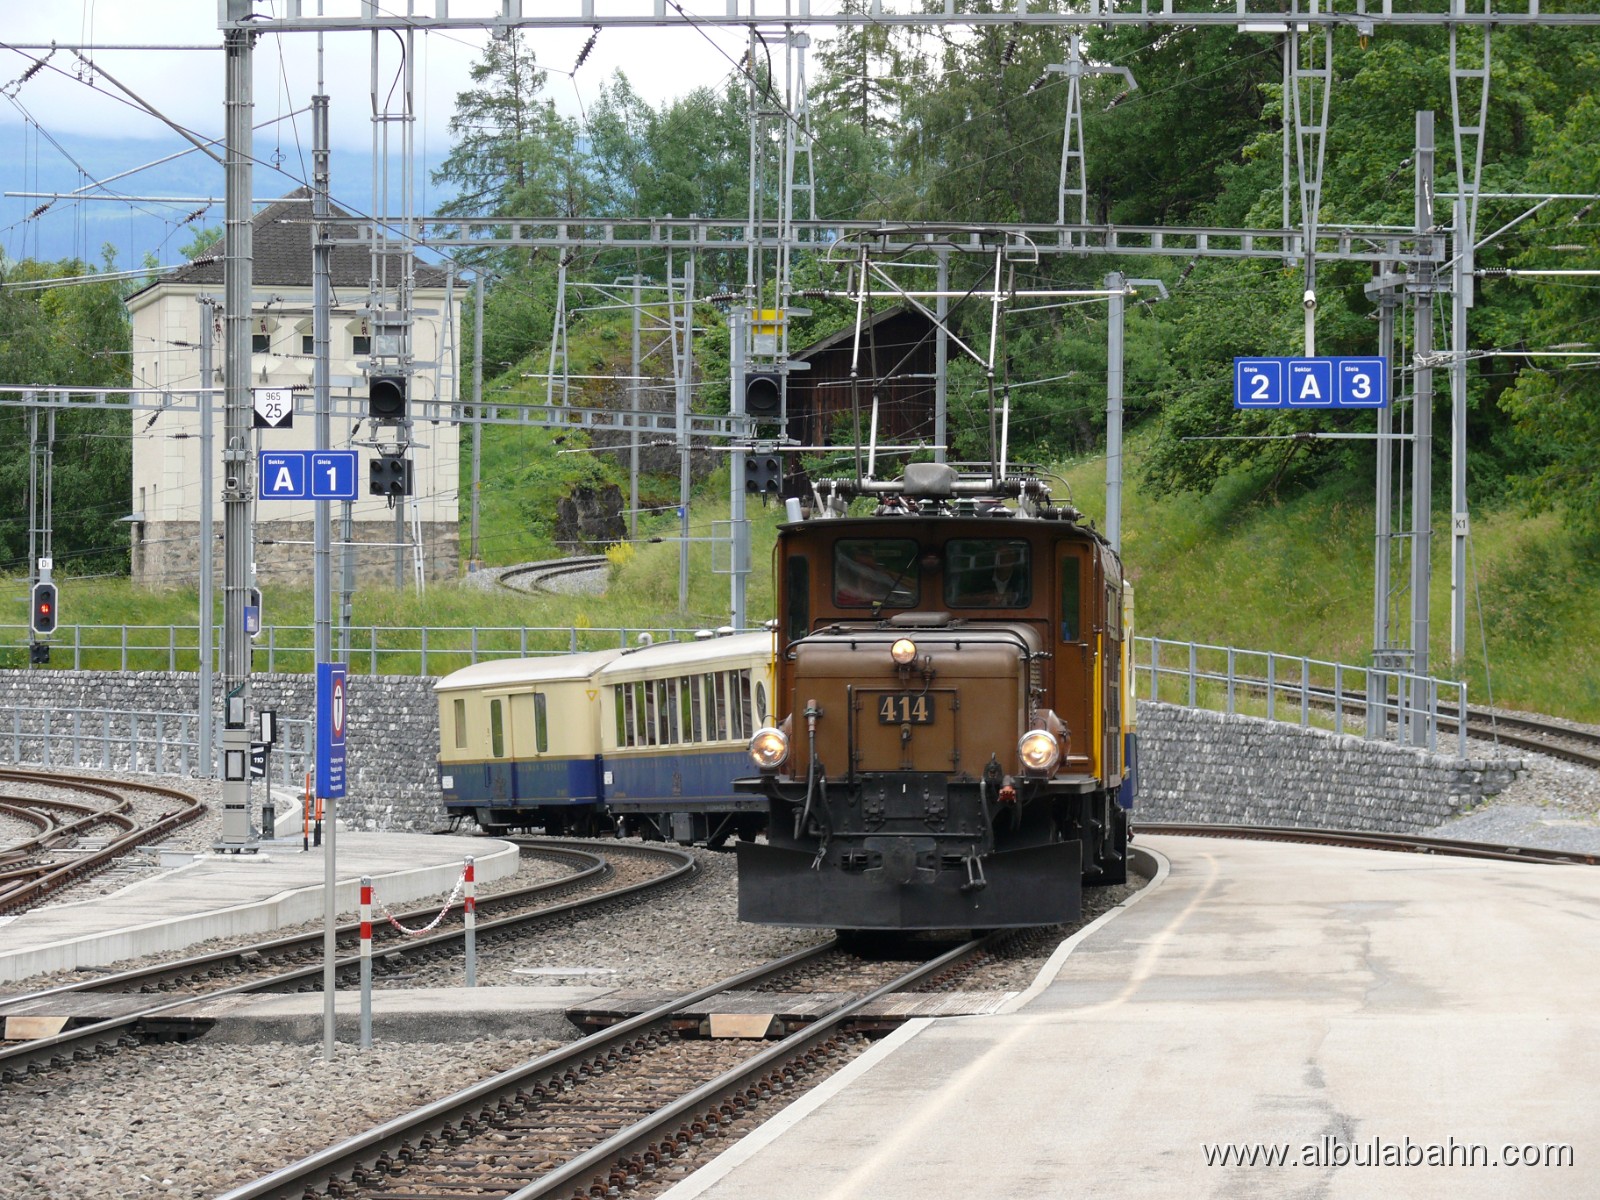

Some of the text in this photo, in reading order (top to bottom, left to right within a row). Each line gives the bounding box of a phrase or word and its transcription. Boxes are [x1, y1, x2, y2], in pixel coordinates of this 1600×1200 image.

[1251, 373, 1371, 399] 2 A 3
[265, 392, 281, 400] 965
[265, 403, 282, 419] 25
[273, 467, 336, 491] A 1
[1455, 519, 1466, 529] K1
[879, 696, 929, 722] 414
[253, 756, 264, 764] 110
